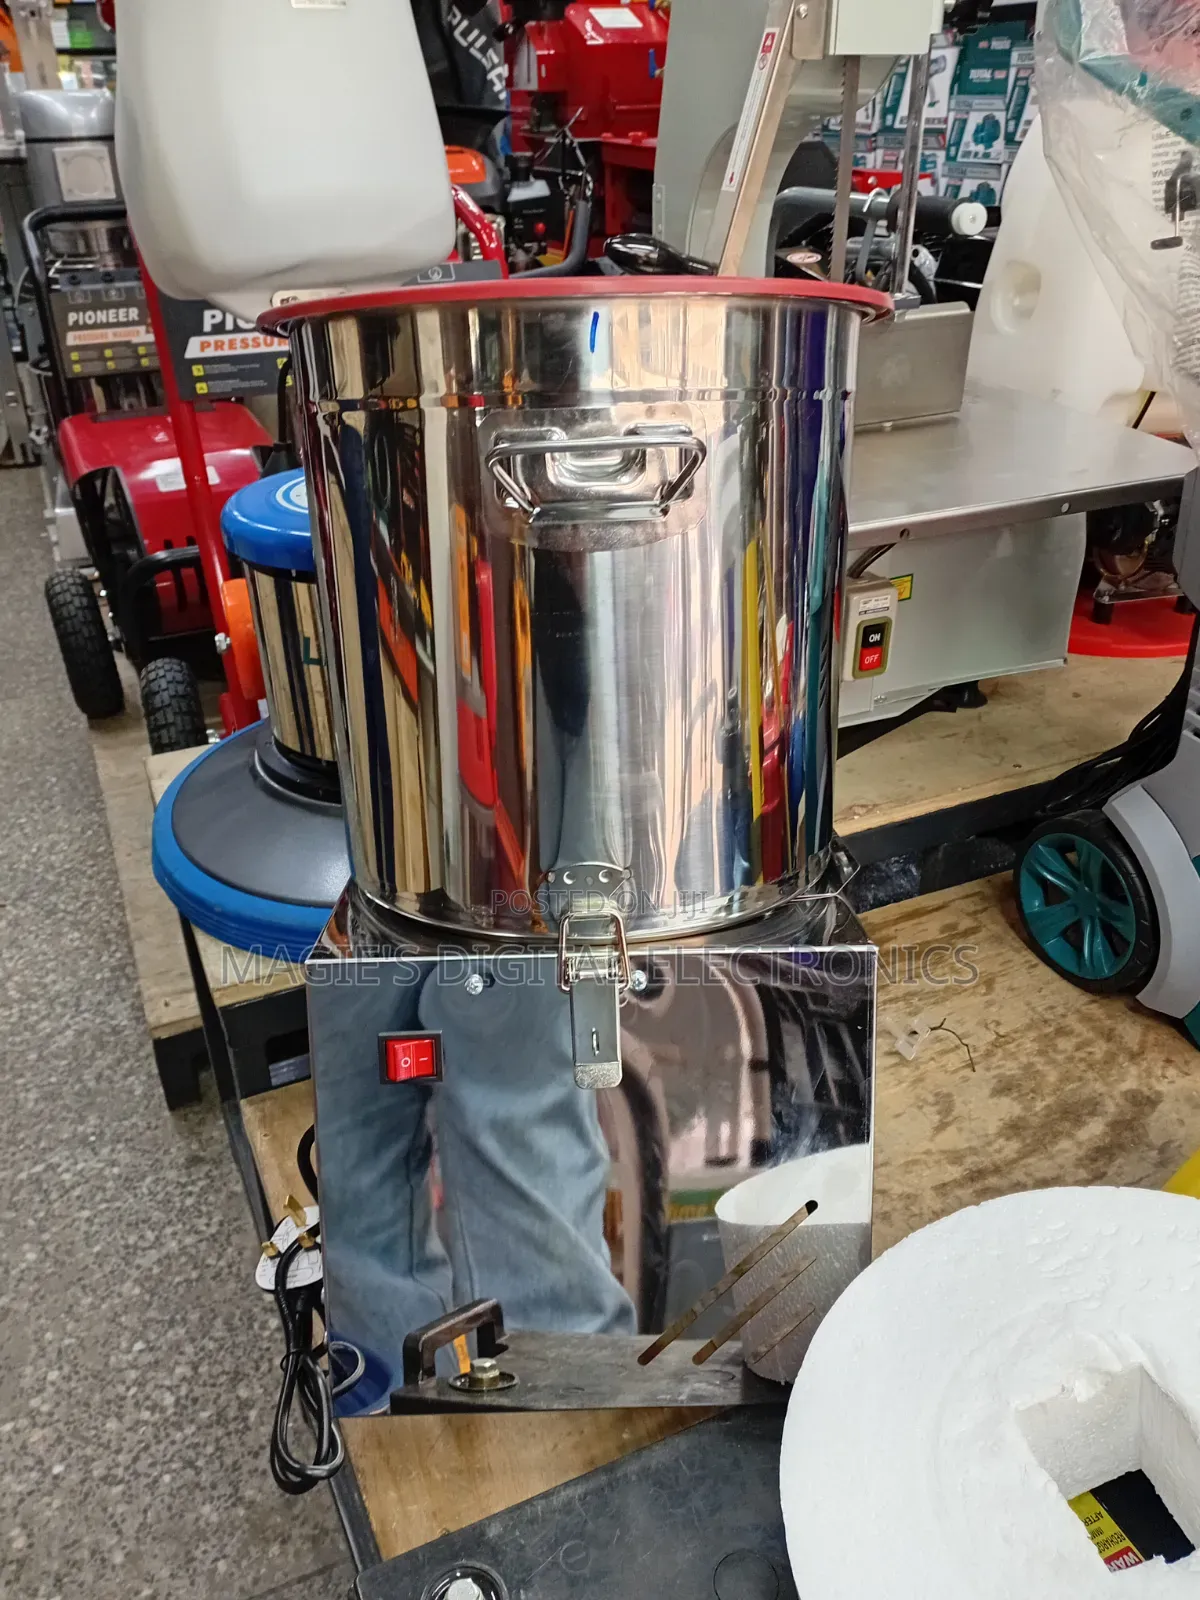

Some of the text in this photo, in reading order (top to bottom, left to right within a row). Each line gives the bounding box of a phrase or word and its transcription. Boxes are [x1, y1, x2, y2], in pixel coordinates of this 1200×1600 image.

[448, 4, 509, 100] PULSA
[67, 307, 139, 326] PIONEER
[869, 633, 881, 643] ON
[864, 654, 879, 664] OFF
